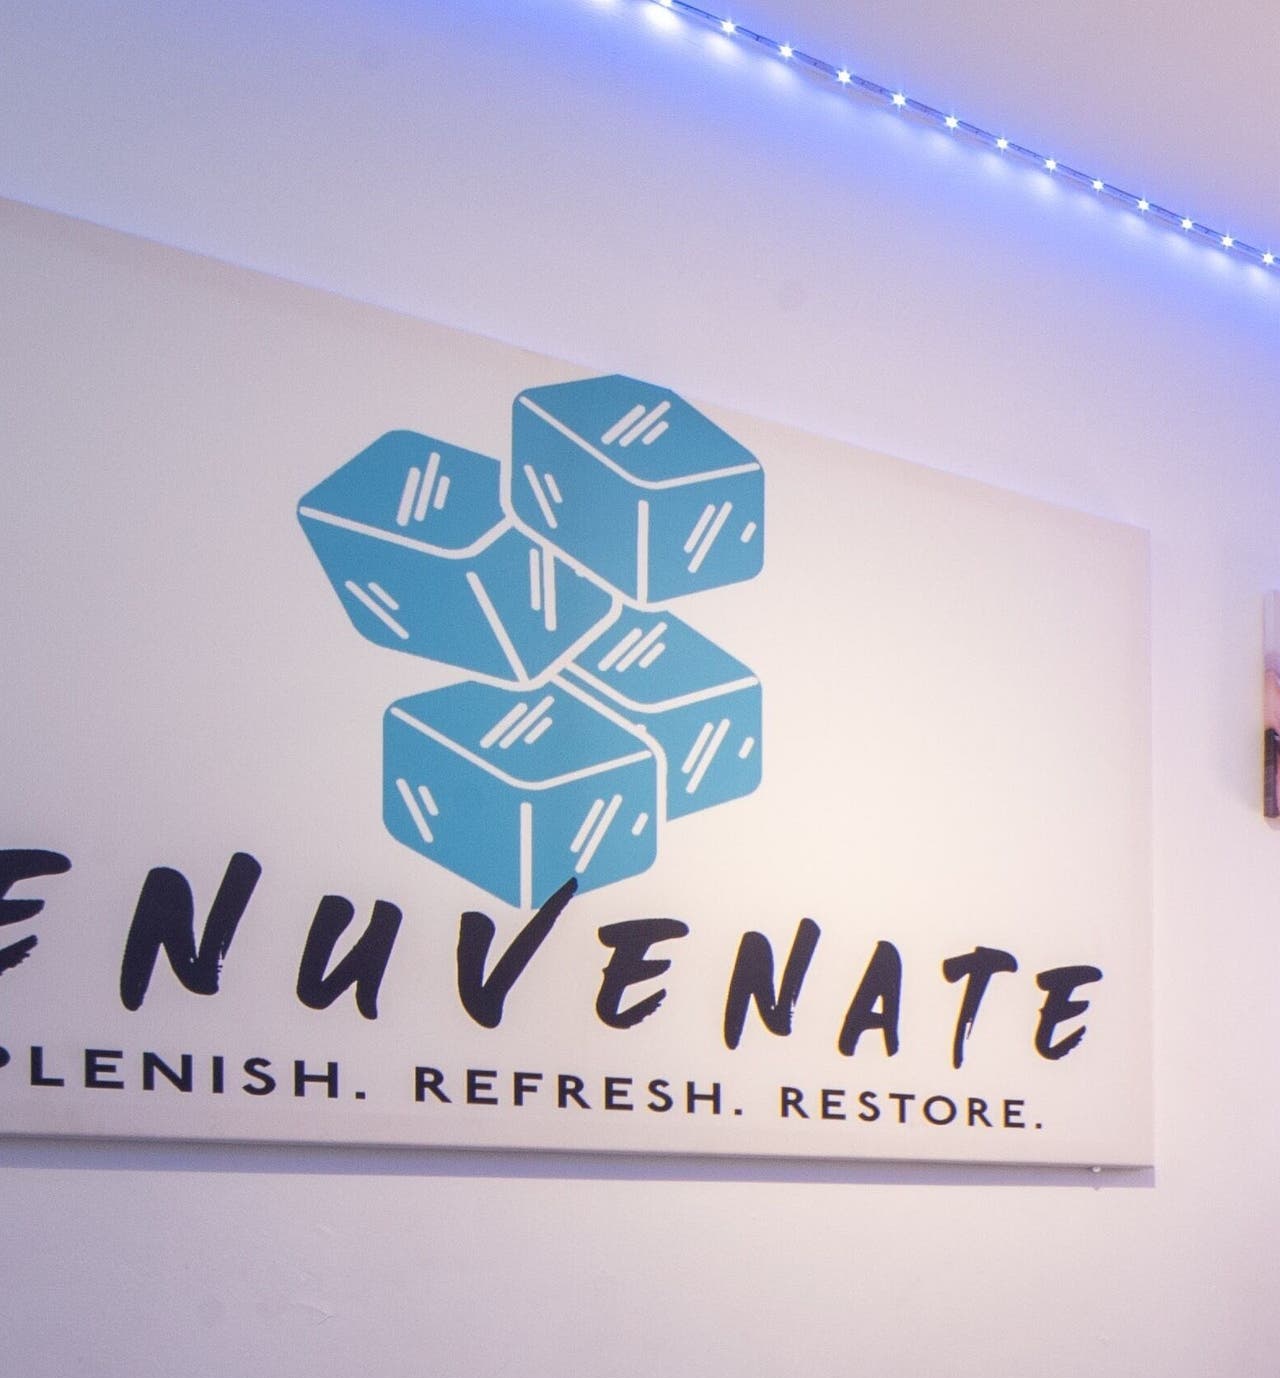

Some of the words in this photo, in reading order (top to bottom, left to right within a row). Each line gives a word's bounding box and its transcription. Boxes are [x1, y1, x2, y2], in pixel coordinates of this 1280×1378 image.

[0, 1046, 366, 1100] LENISH.
[415, 1066, 743, 1116] REFRESH.
[781, 1086, 1043, 1129] RESTORE.
